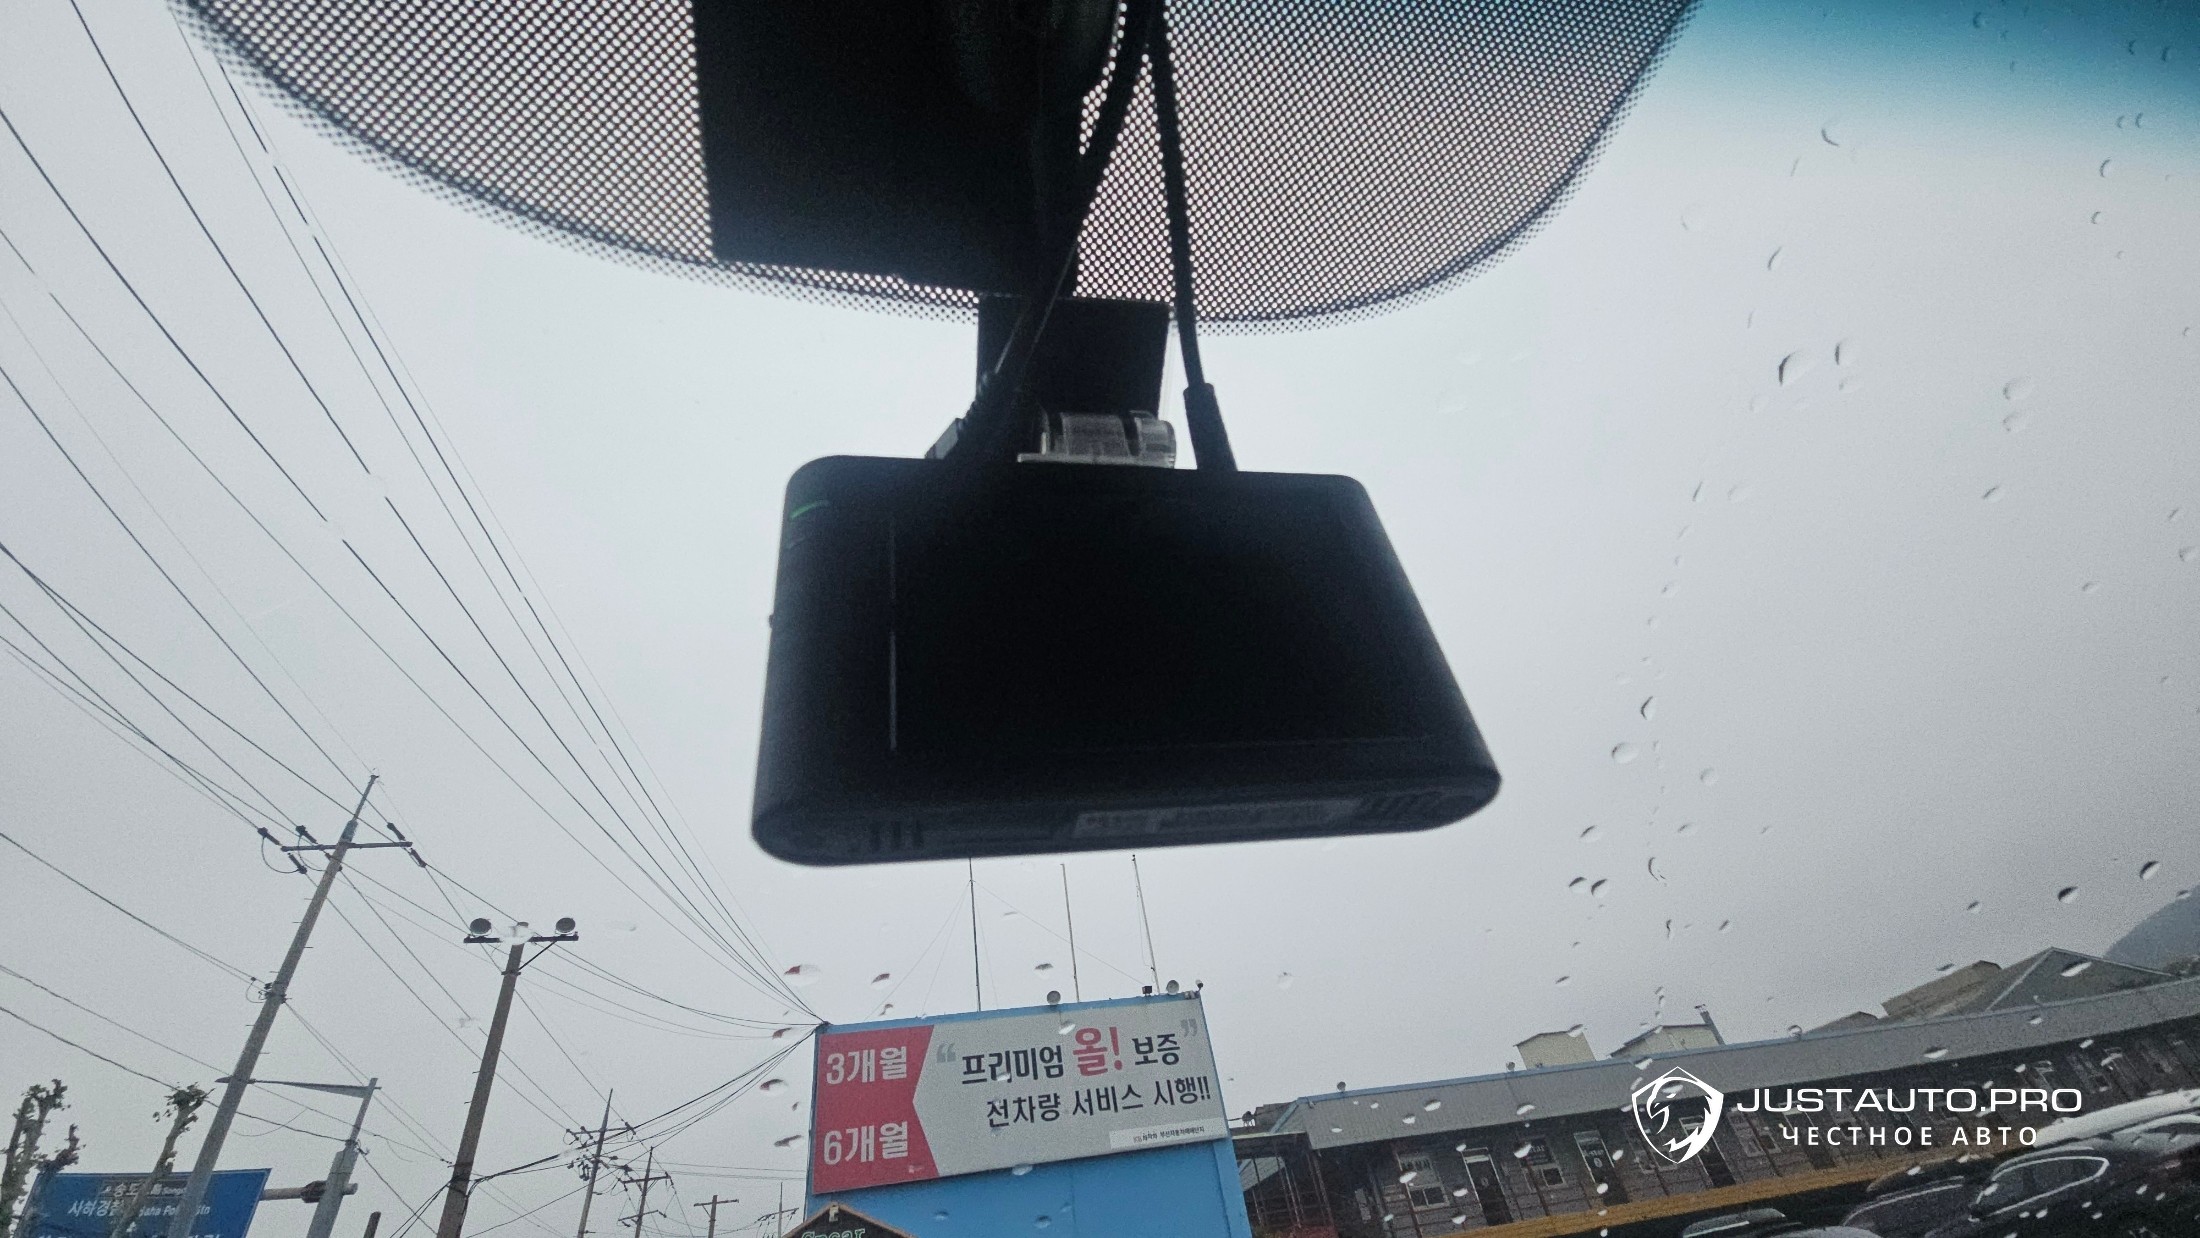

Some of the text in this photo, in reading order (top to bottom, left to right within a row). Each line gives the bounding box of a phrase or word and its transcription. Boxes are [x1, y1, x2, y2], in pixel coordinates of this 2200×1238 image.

[826, 1045, 908, 1086] 3개월
[1073, 1027, 1123, 1077] 올!
[986, 1075, 1211, 1129] 전차량 서비스 시행!!
[823, 1121, 909, 1166] 6개월
